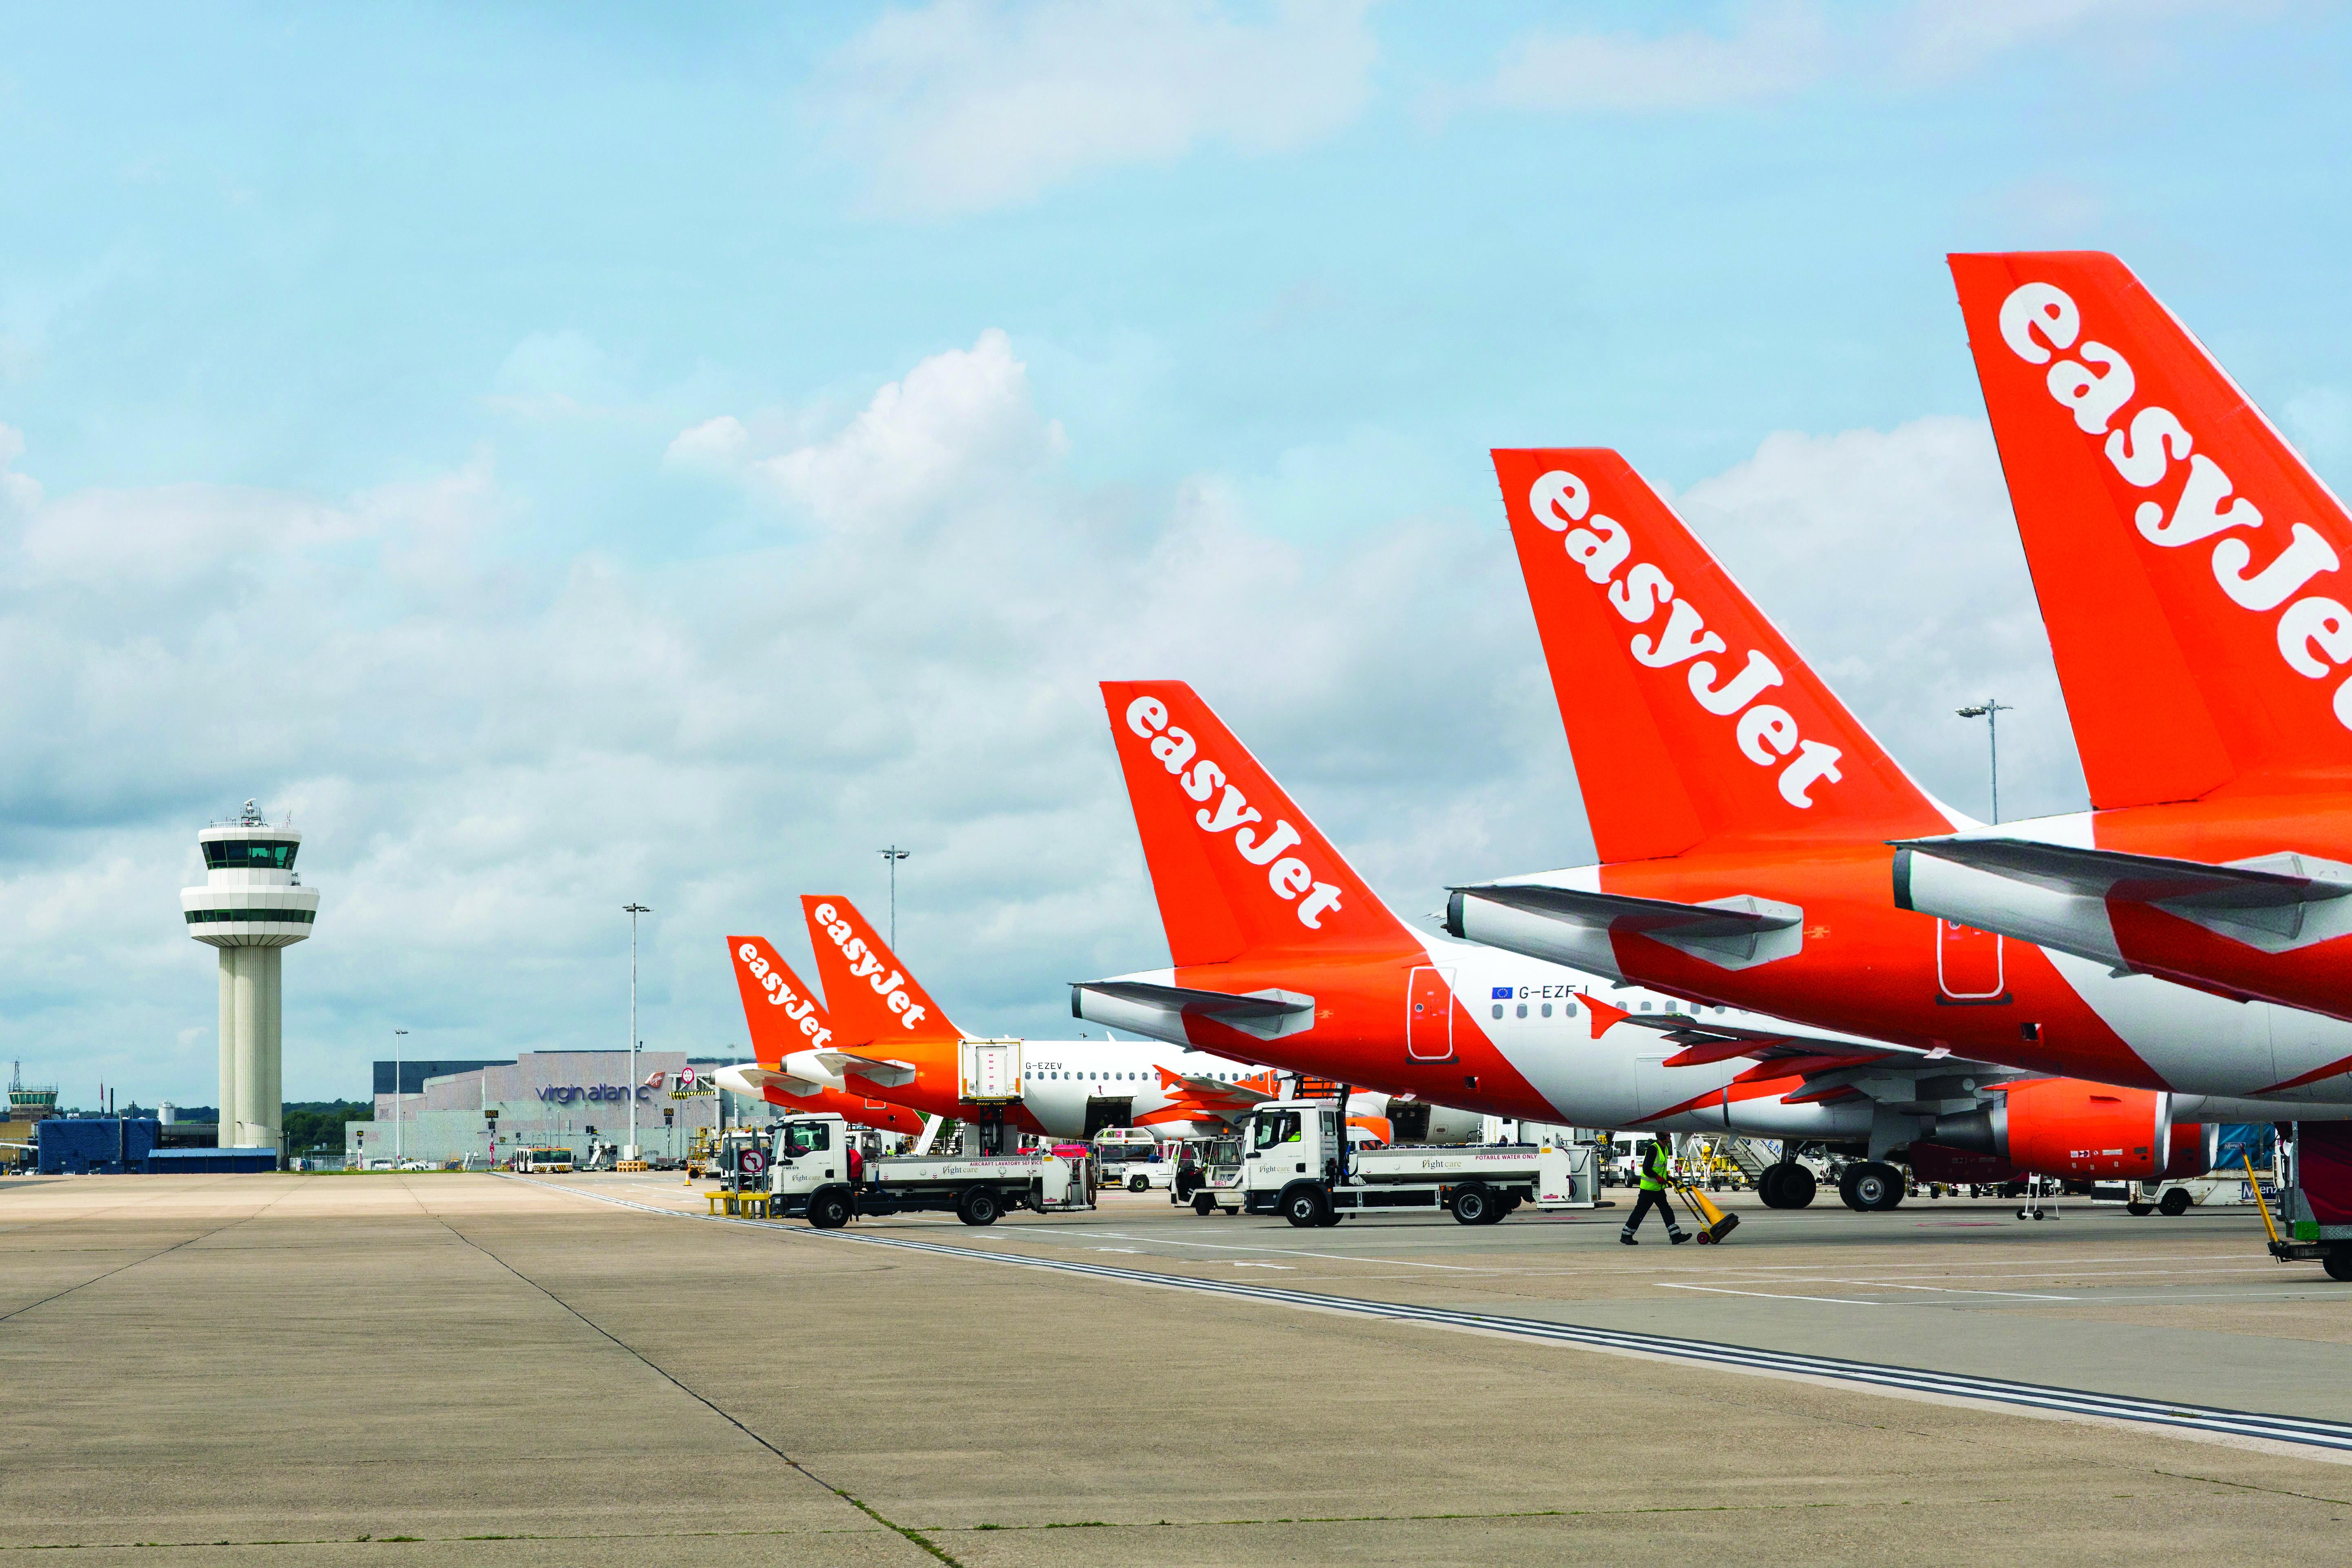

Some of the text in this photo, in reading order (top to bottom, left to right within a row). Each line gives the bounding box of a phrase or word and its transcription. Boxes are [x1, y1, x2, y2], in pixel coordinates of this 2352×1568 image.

[1999, 282, 2352, 732] easyJe
[1529, 470, 1842, 809] easyJet
[1126, 696, 1342, 929] easyJet
[739, 943, 832, 1049] easyJet
[815, 903, 926, 1030] easyJet
[535, 1084, 584, 1104] virgin
